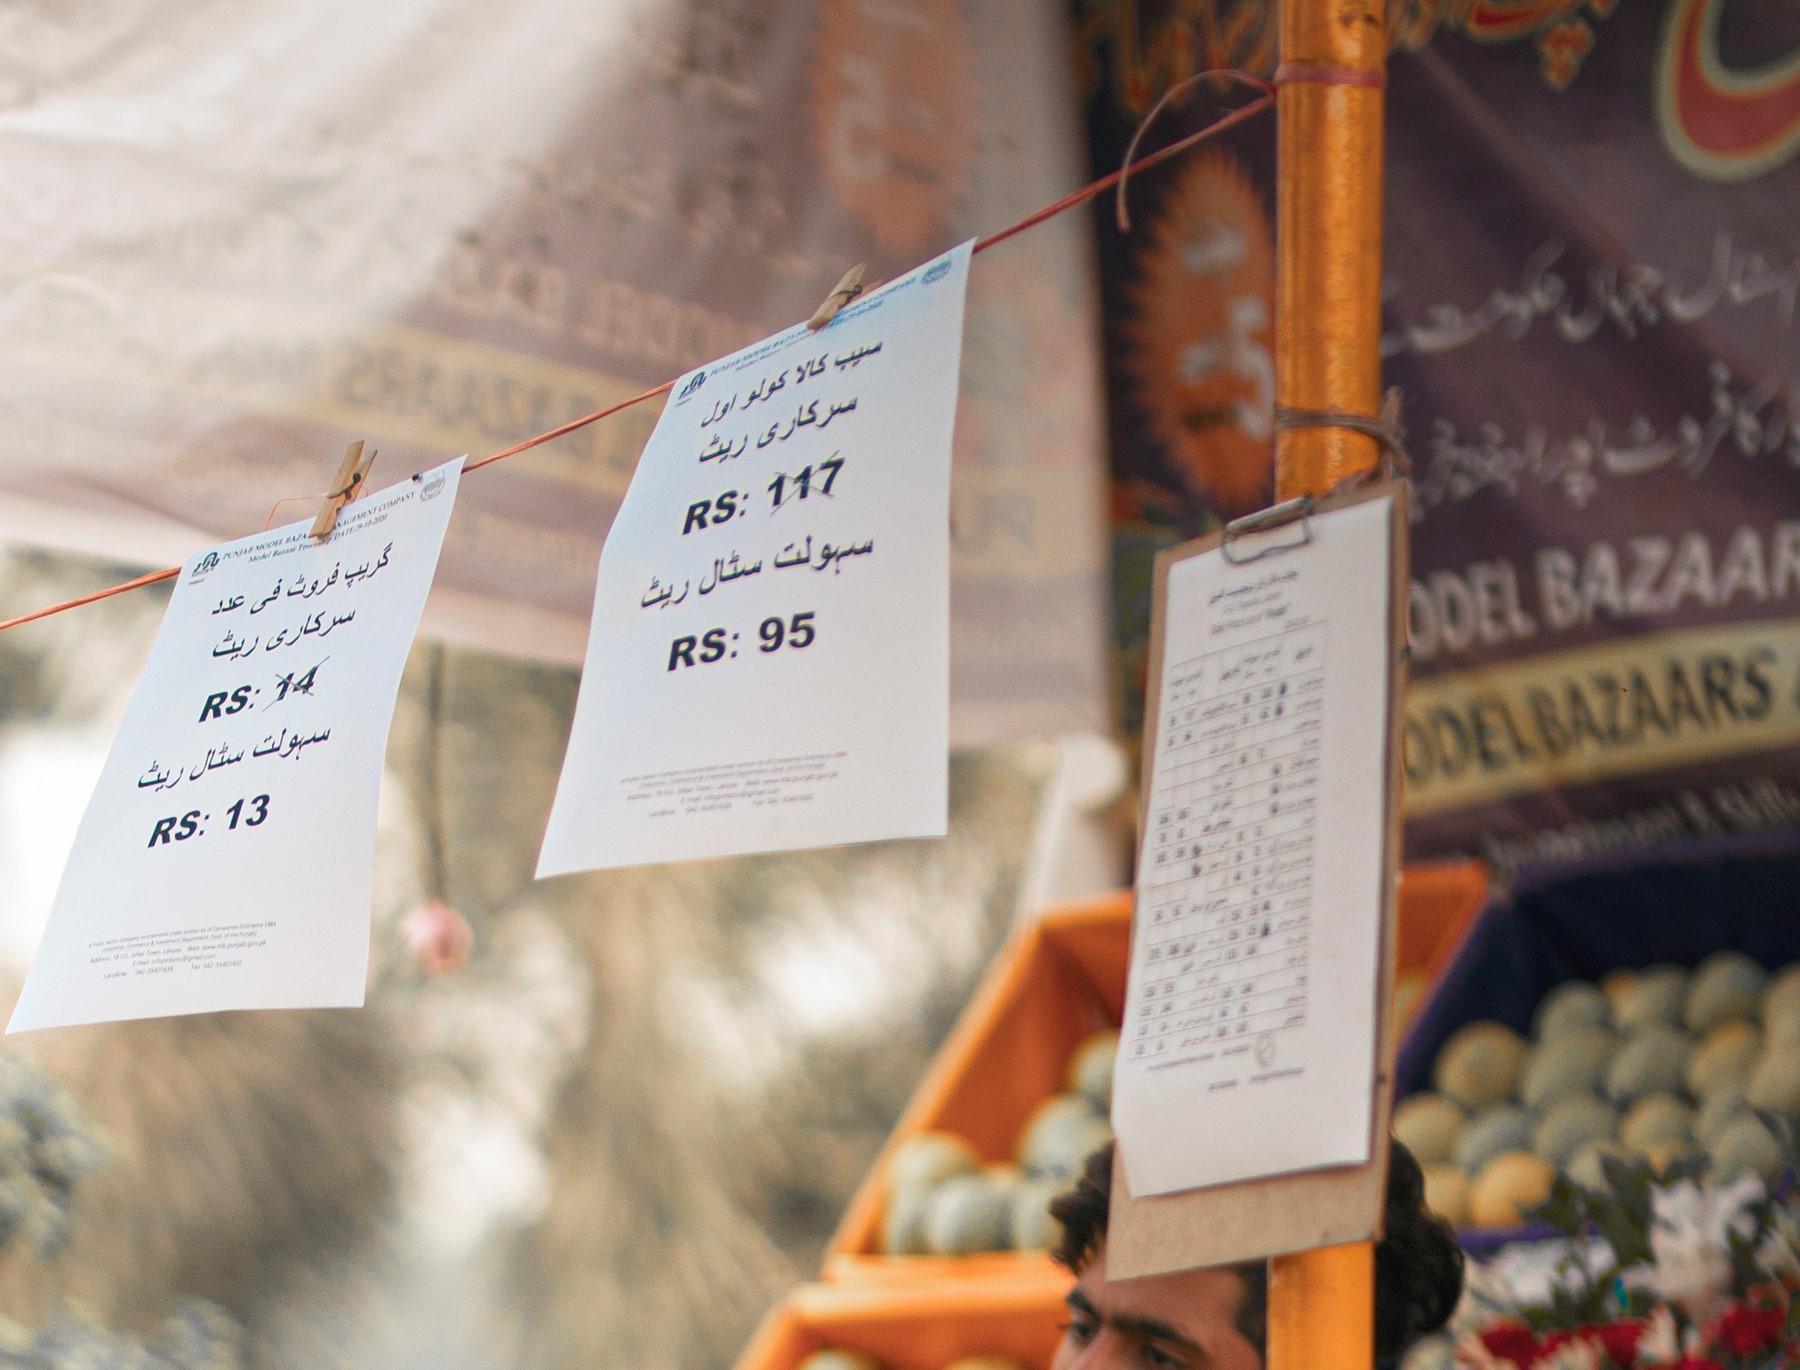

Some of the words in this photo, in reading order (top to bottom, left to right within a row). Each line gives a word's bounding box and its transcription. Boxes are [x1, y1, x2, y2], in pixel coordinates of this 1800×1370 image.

[796, 353, 829, 385] کالا
[834, 341, 883, 371] سیب
[741, 369, 789, 409] کولو
[701, 394, 737, 428] اول
[757, 398, 858, 448] سرکاری
[699, 434, 749, 463] ریٹ
[682, 489, 749, 535] RS:
[767, 457, 845, 507] 117
[344, 541, 393, 588] گریپ
[698, 551, 762, 595] سٹال
[774, 535, 874, 574] سہولت
[250, 578, 283, 615] فی
[287, 562, 340, 598] فروٹ
[641, 576, 690, 608] ریٹ
[212, 595, 245, 615] عدد
[1406, 556, 1536, 662] ODEL
[213, 629, 260, 661] ریٹ
[266, 609, 356, 651] سرکاری
[667, 627, 740, 671] RS:
[758, 611, 816, 653] 95
[199, 685, 261, 723] RS:
[276, 666, 319, 702] 14
[252, 728, 331, 760] سہولت
[1405, 695, 1536, 788] ODEL
[138, 759, 184, 792] ریٹ
[189, 742, 245, 781] سٹال
[147, 810, 210, 848] RS:
[226, 794, 270, 830] 13
